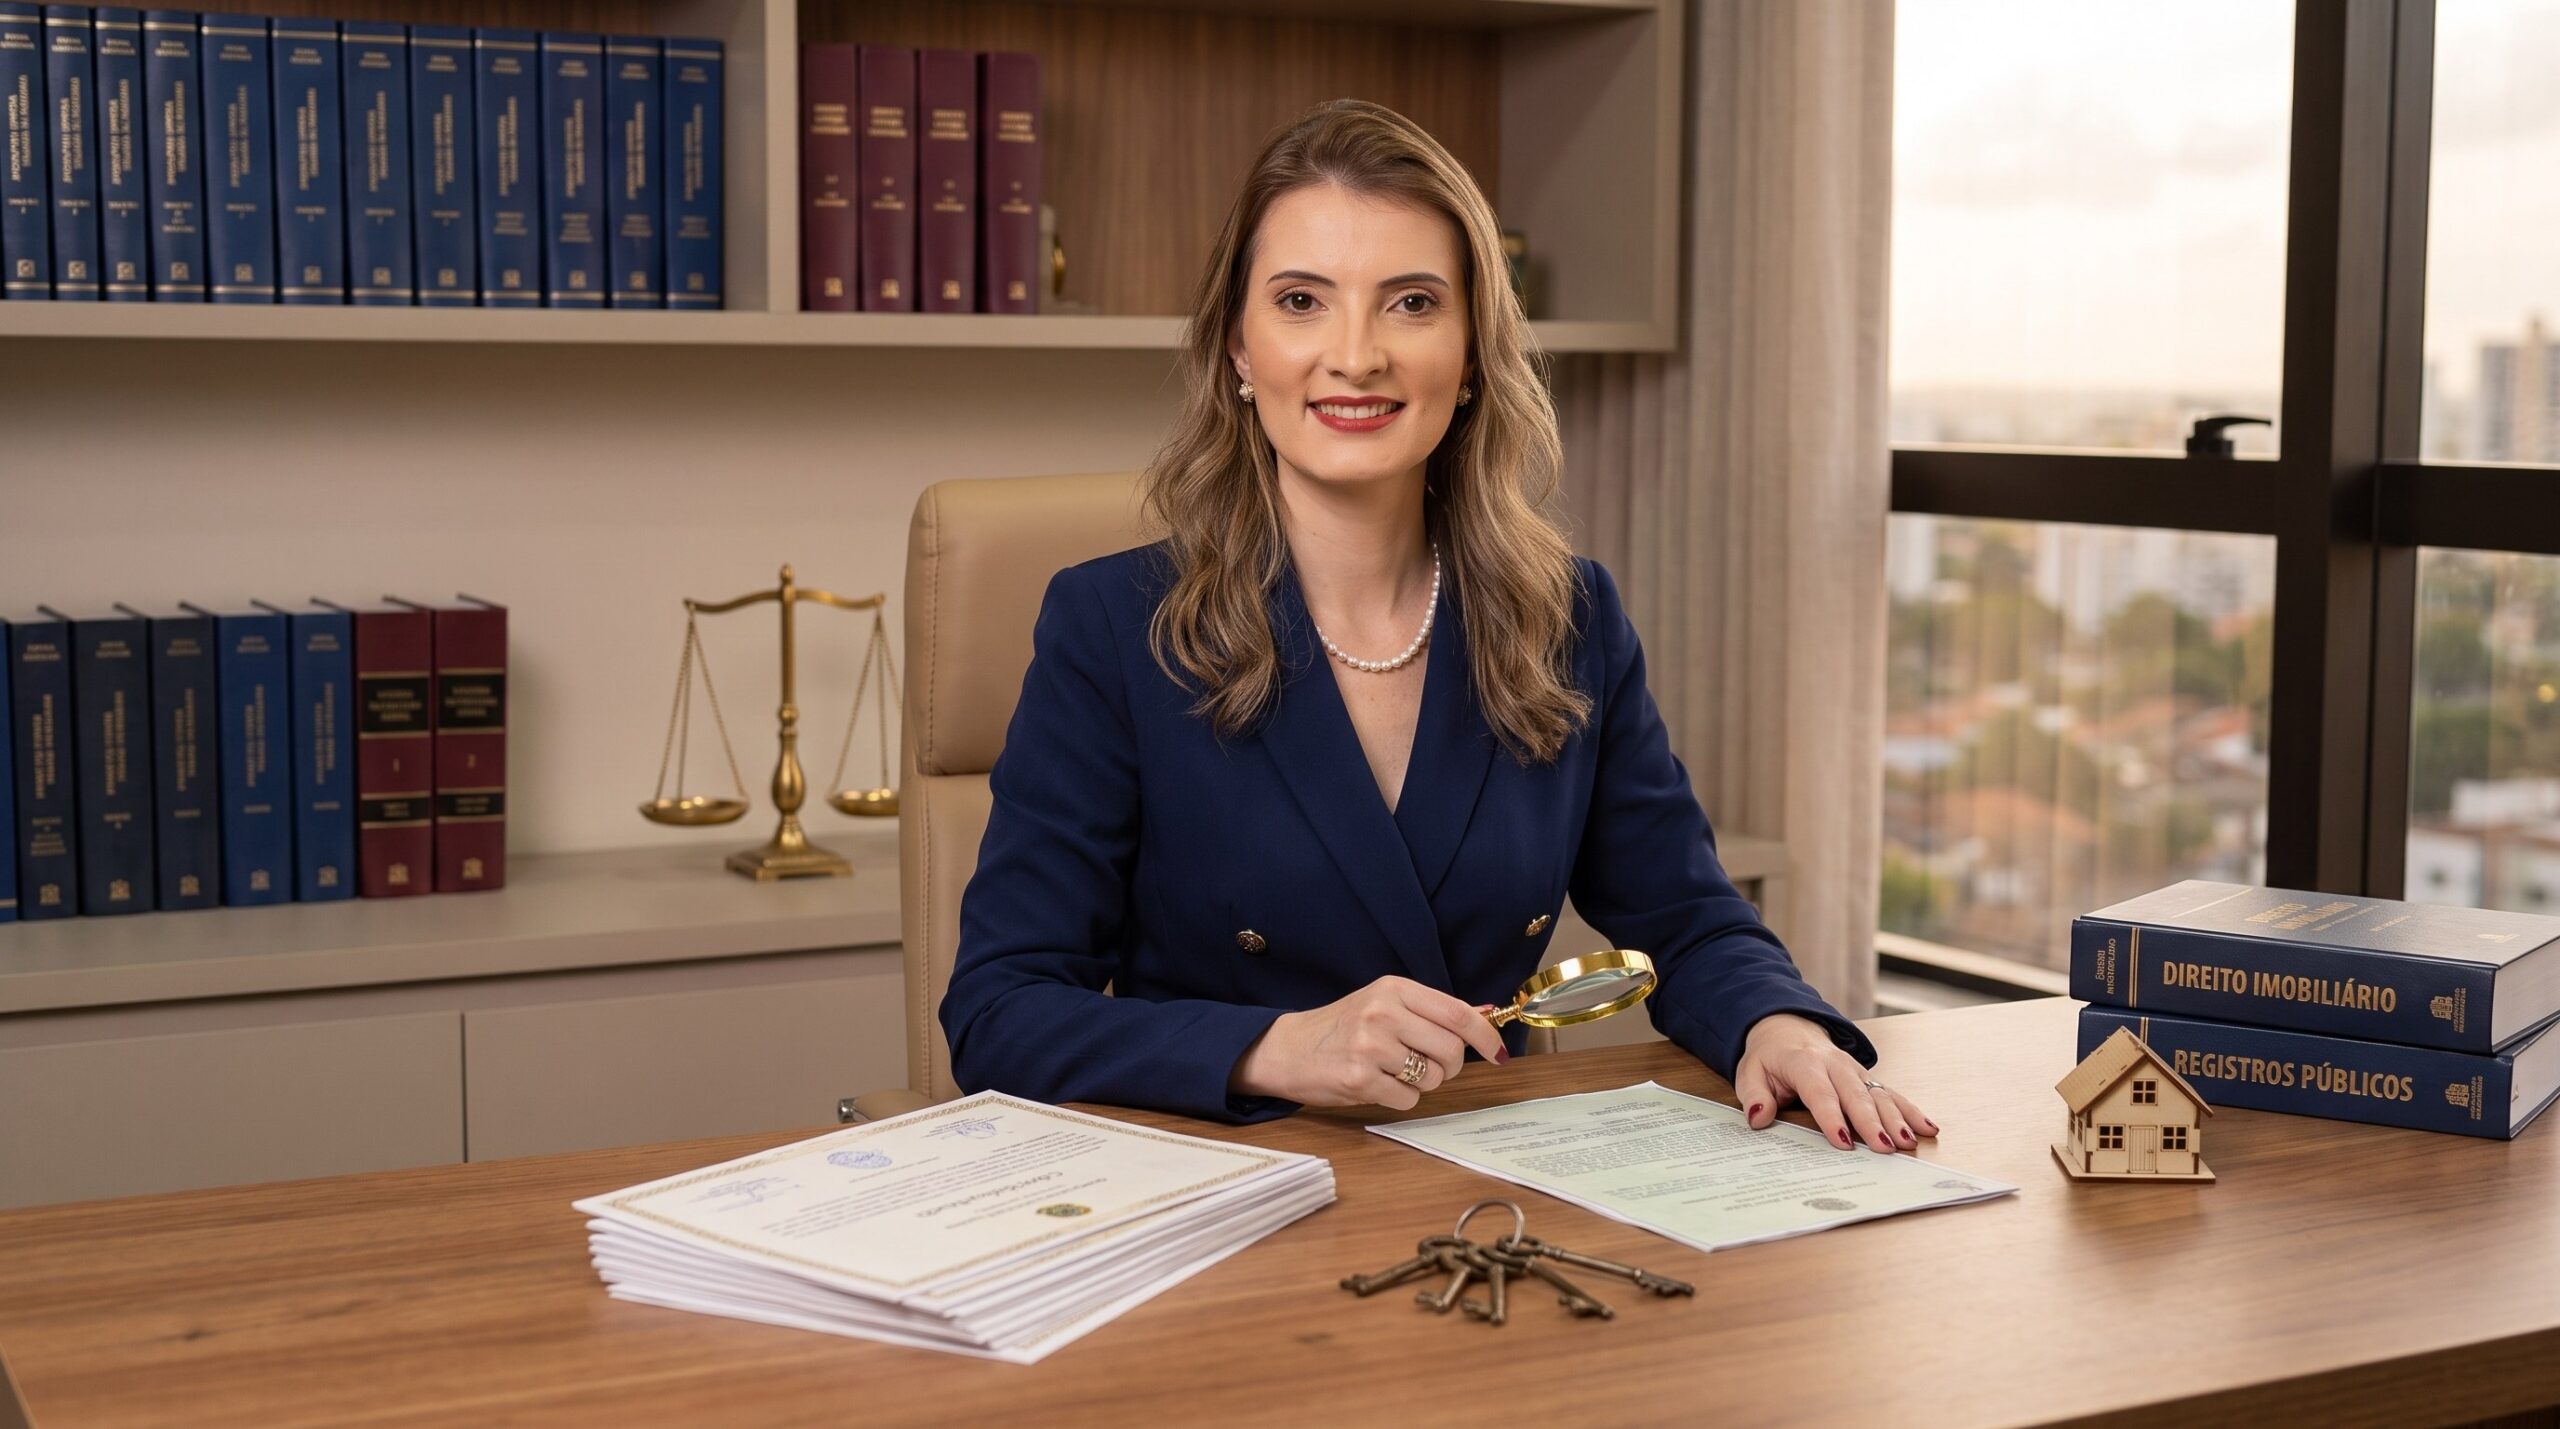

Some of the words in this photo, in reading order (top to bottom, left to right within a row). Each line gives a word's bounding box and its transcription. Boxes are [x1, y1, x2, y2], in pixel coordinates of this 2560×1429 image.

[2163, 961, 2247, 994] DIREITO
[2253, 972, 2397, 1013] IMOBILIÁRIO
[2174, 1049, 2295, 1087] REGISTROS
[2301, 1062, 2413, 1102] PÚBLICOS
